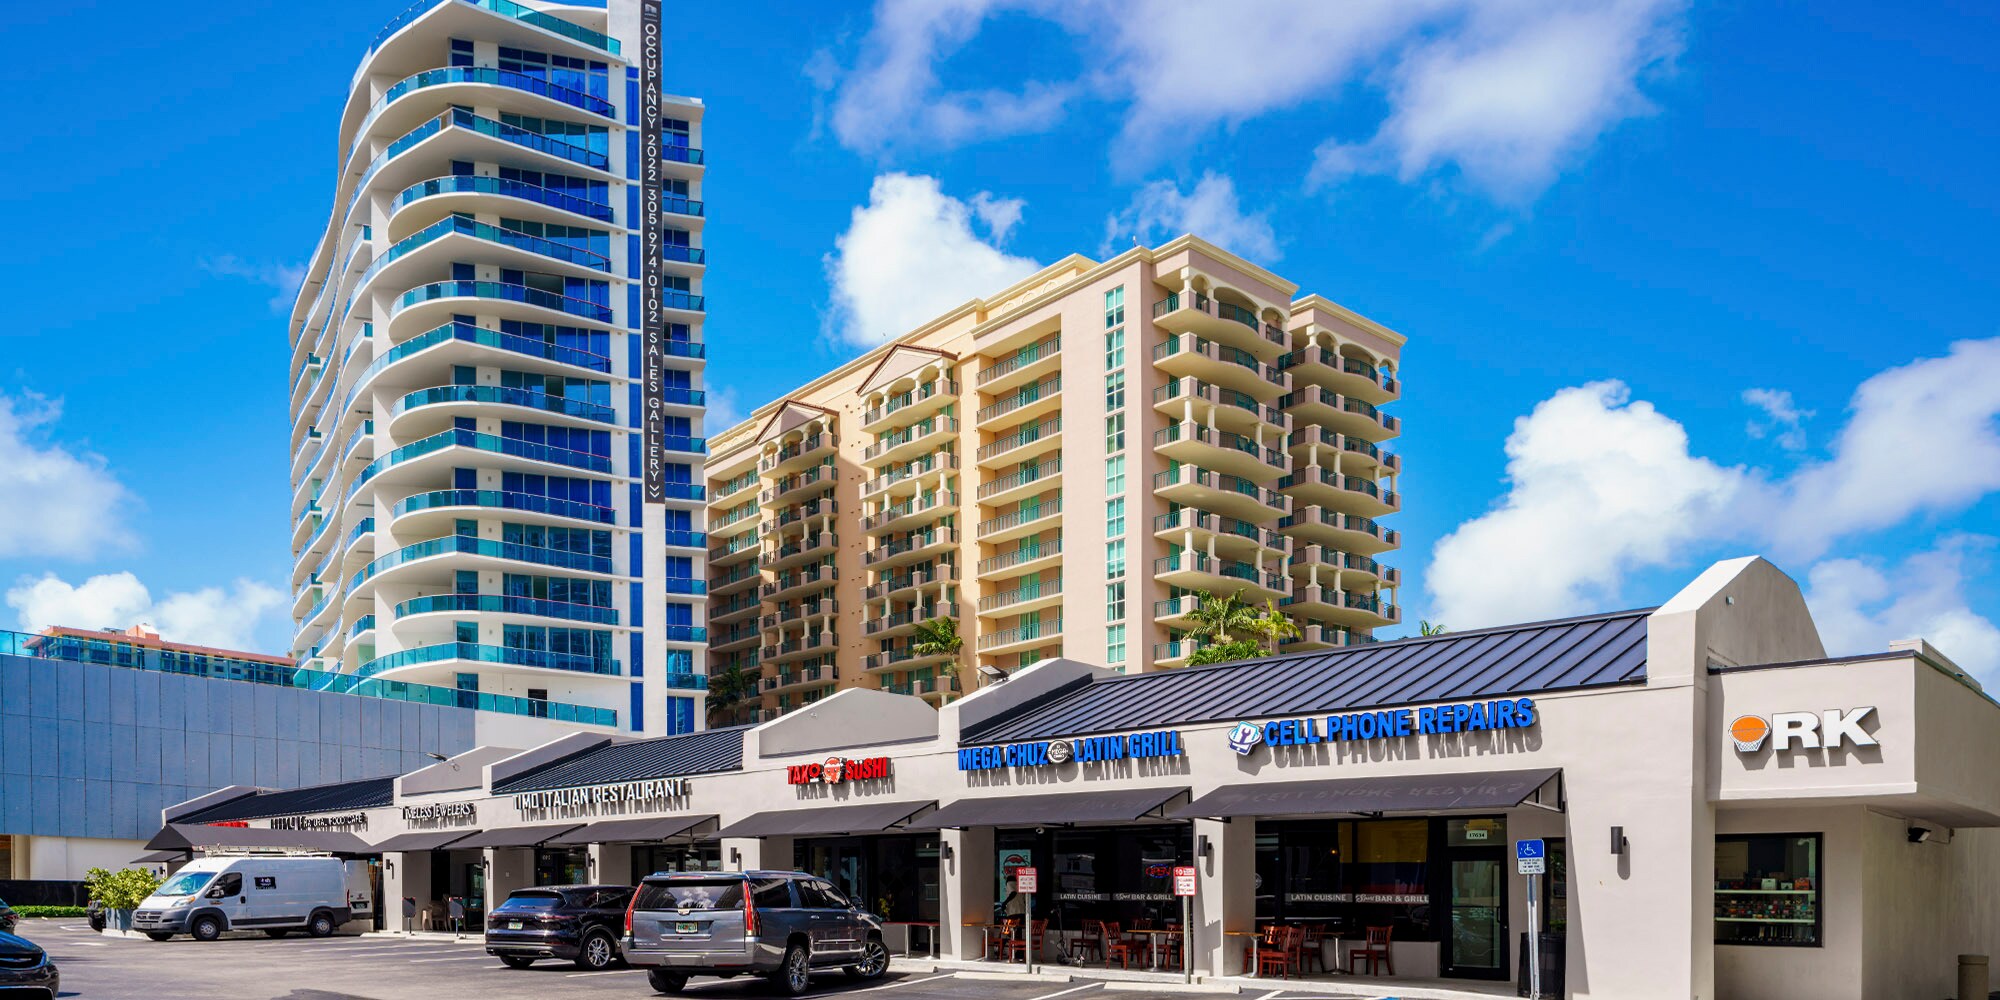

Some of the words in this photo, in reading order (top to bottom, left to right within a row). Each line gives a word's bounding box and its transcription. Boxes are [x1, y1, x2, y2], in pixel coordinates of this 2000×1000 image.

[645, 23, 657, 129] OCCUPANCY
[648, 134, 657, 182] 2022
[649, 332, 659, 393] SALES
[649, 398, 660, 482] GALLERY
[1264, 718, 1320, 747] CELL
[1327, 709, 1412, 741] PHONE
[1419, 698, 1535, 735] REPAIRS
[958, 745, 1001, 770] MEGA
[1074, 736, 1124, 763] LATIN
[1129, 730, 1181, 758] GRILL
[787, 763, 820, 785] TAKO
[513, 793, 539, 810] TIMO
[542, 788, 588, 809] ITALIAN
[593, 777, 686, 803] RESTAURANT
[329, 816, 345, 825] FOOD
[433, 803, 472, 819] JEWELERS
[1146, 867, 1171, 876] OPEN
[1175, 868, 1184, 876] 10
[1375, 894, 1392, 902] BAR
[1395, 894, 1401, 902] &
[1404, 894, 1429, 903] GRILL
